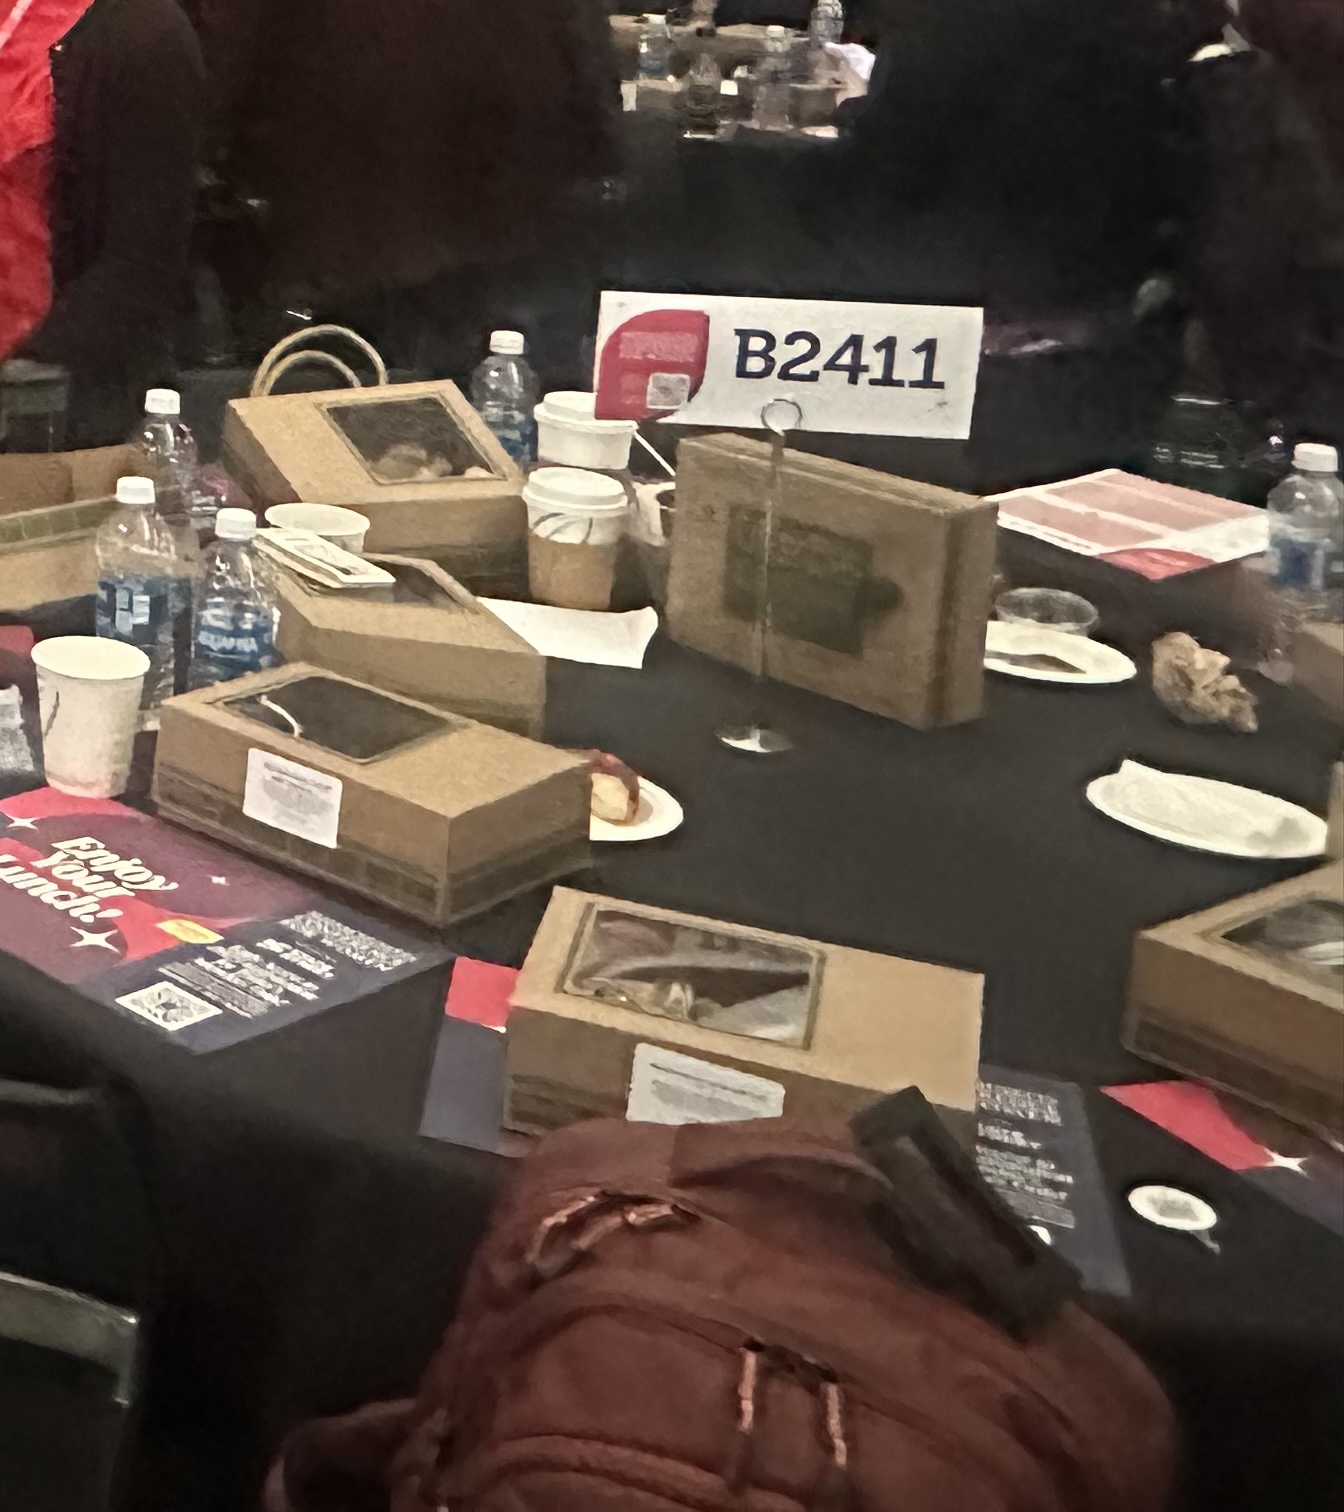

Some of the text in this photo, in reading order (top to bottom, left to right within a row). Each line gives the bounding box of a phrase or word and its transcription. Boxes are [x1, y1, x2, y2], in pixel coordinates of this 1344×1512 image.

[734, 329, 945, 389] B2411
[30, 850, 135, 898] Your
[51, 836, 179, 890] Enjoy
